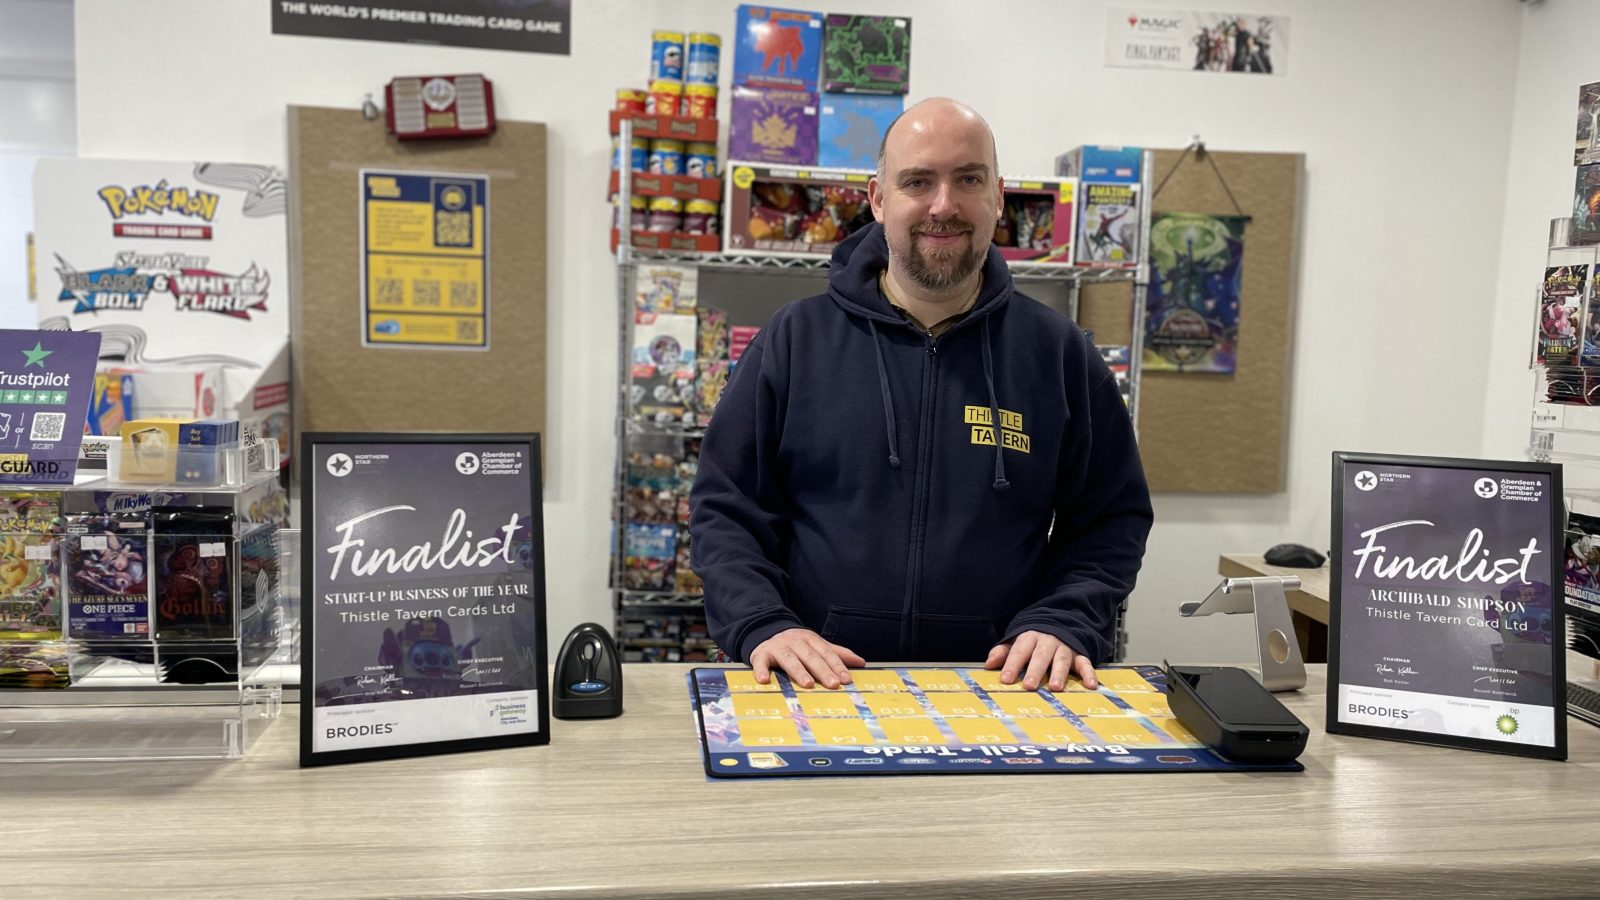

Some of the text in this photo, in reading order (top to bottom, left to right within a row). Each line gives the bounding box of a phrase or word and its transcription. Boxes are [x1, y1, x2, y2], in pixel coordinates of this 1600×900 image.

[282, 2, 562, 33] THE WORLD'S PREMIER TRADING CARD GAME
[1141, 17, 1181, 28] MAGIC
[123, 225, 203, 237] TRADING CARD GAME
[153, 274, 169, 292] &
[174, 275, 257, 294] WHITE
[94, 293, 147, 311] BOLT
[176, 293, 252, 313] FLARE
[0, 371, 70, 388] rustpilot
[967, 408, 1020, 428] THITLE
[327, 505, 523, 581] Finalist
[1353, 520, 1542, 585] Finalist
[324, 584, 529, 605] START-UP BUSINESS OF THE YEAR
[1368, 589, 1526, 613] ARCHIBALD SIMPSON
[82, 604, 135, 614] ONE PIECE
[340, 603, 516, 623] Thistle Tavern Cards Ltd
[1366, 607, 1528, 632] Thistle Tavern Card Ltd
[1349, 703, 1409, 719] BRODIES
[1510, 707, 1520, 715] bp
[326, 723, 393, 739] BRODIES
[904, 735, 930, 743] £3
[1047, 734, 1070, 742] £1
[862, 744, 1130, 757] Buy Sell Trade
